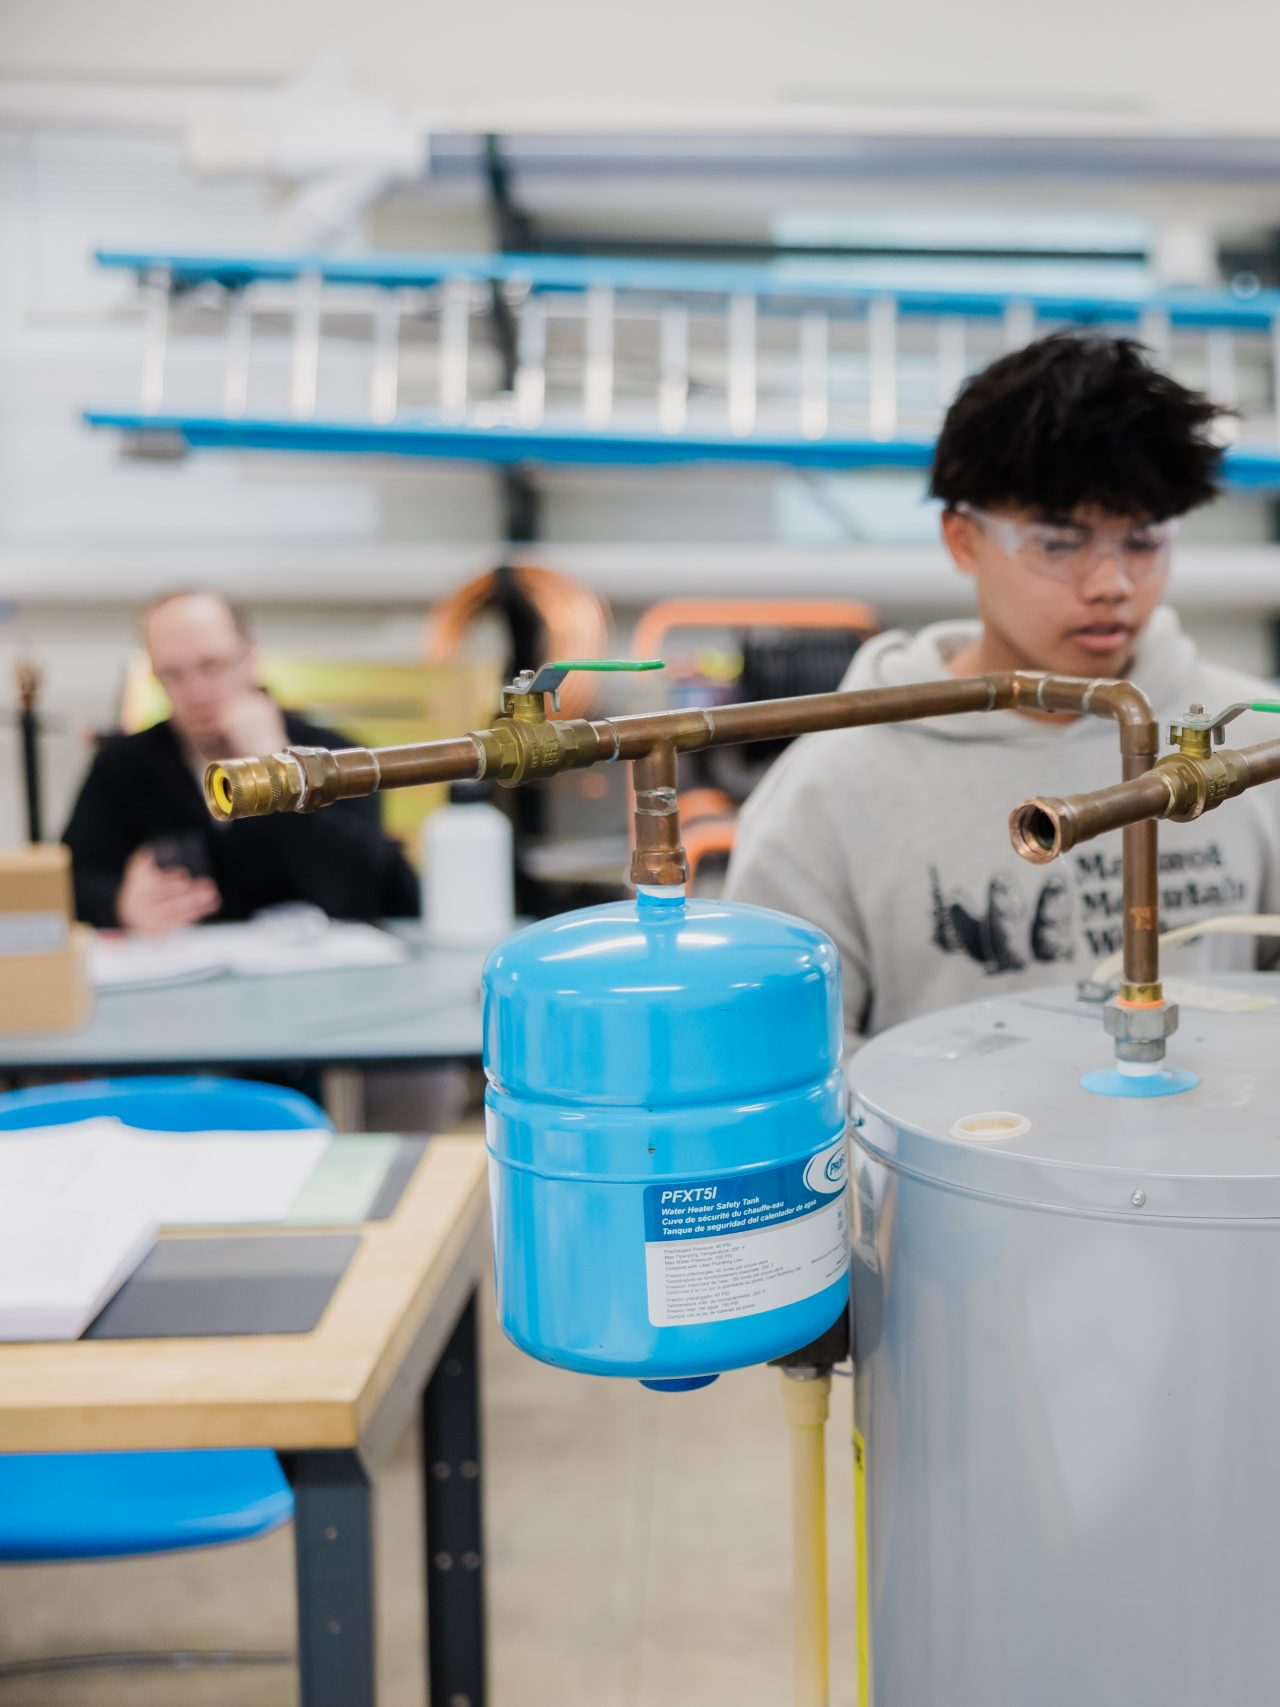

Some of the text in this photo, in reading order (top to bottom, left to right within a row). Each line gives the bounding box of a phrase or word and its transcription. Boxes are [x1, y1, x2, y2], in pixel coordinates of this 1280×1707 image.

[1077, 842, 1221, 881] Mamot
[661, 1196, 760, 1216] Water Heater Safety Tank
[661, 1201, 785, 1226] Cuve de sécurité du chauffe-eau
[663, 1199, 817, 1235] Tanque de seguridad del calentador de agua
